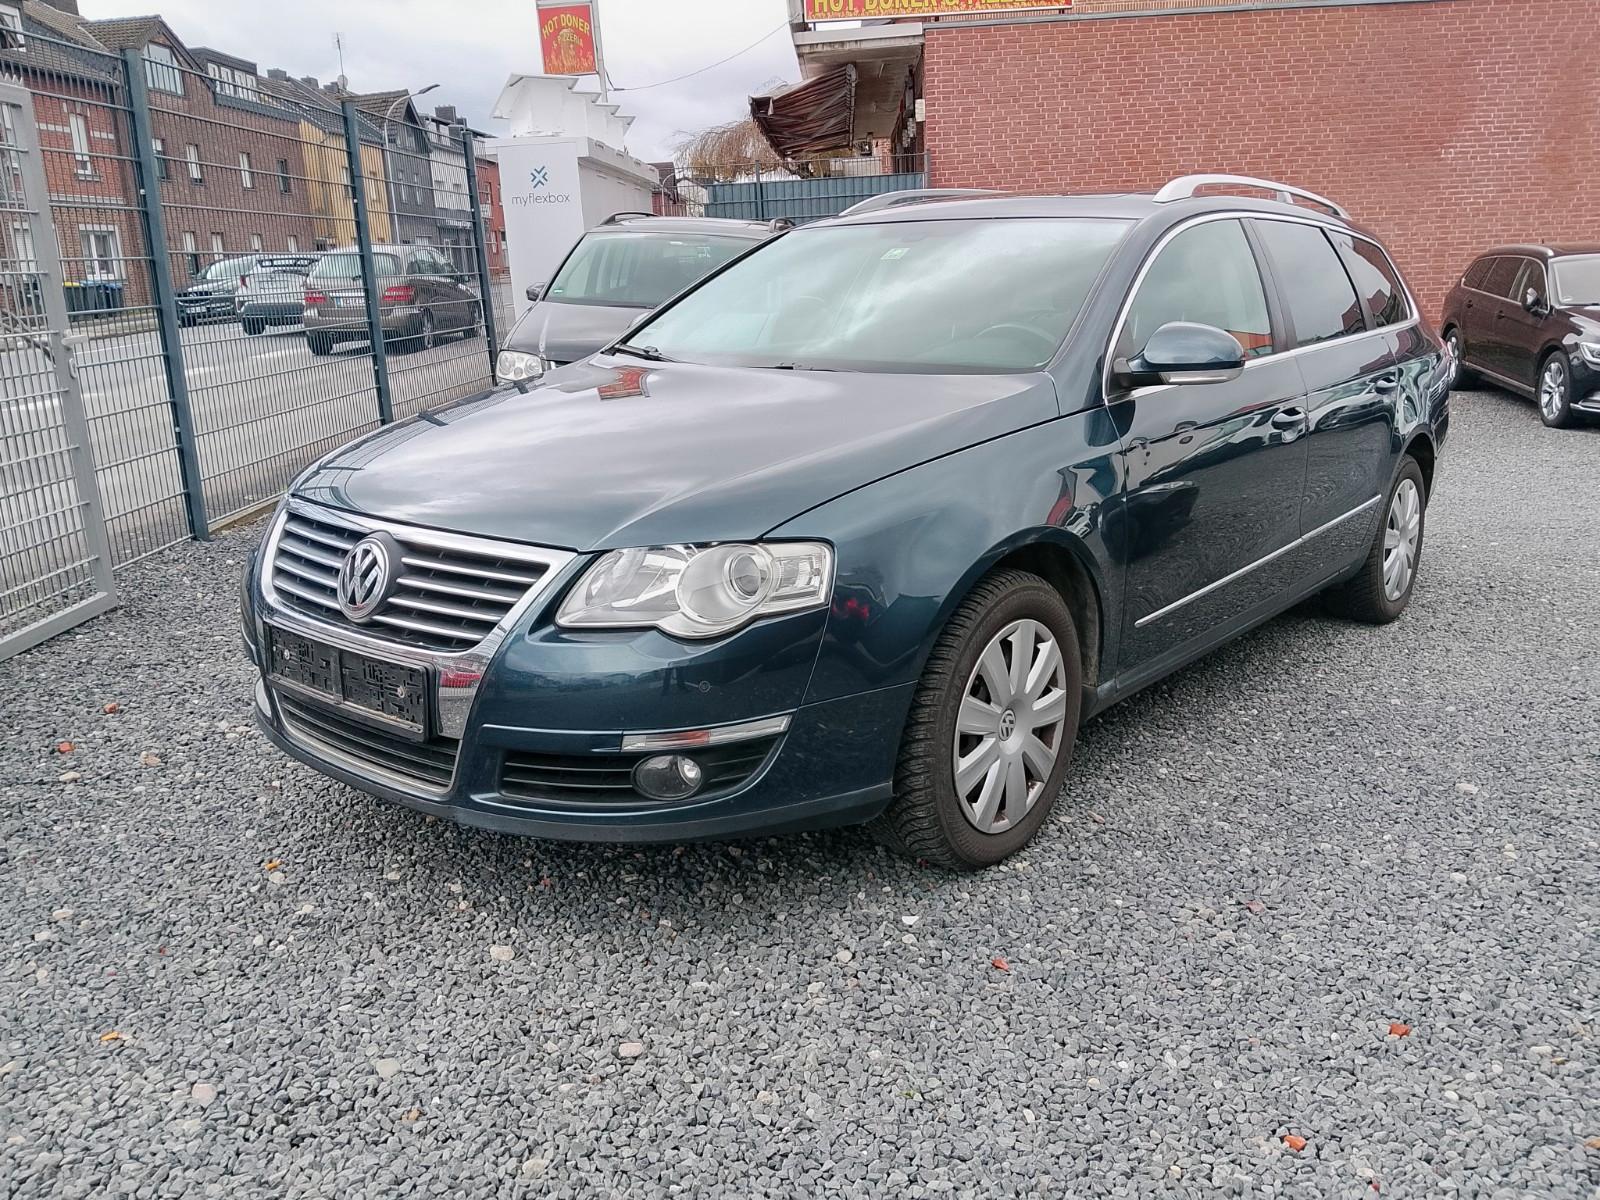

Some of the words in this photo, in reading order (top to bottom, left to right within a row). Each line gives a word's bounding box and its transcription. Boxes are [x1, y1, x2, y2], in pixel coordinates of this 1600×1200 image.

[542, 15, 558, 40] HOT
[560, 13, 590, 37] DONER
[511, 192, 571, 208] myflexbox
